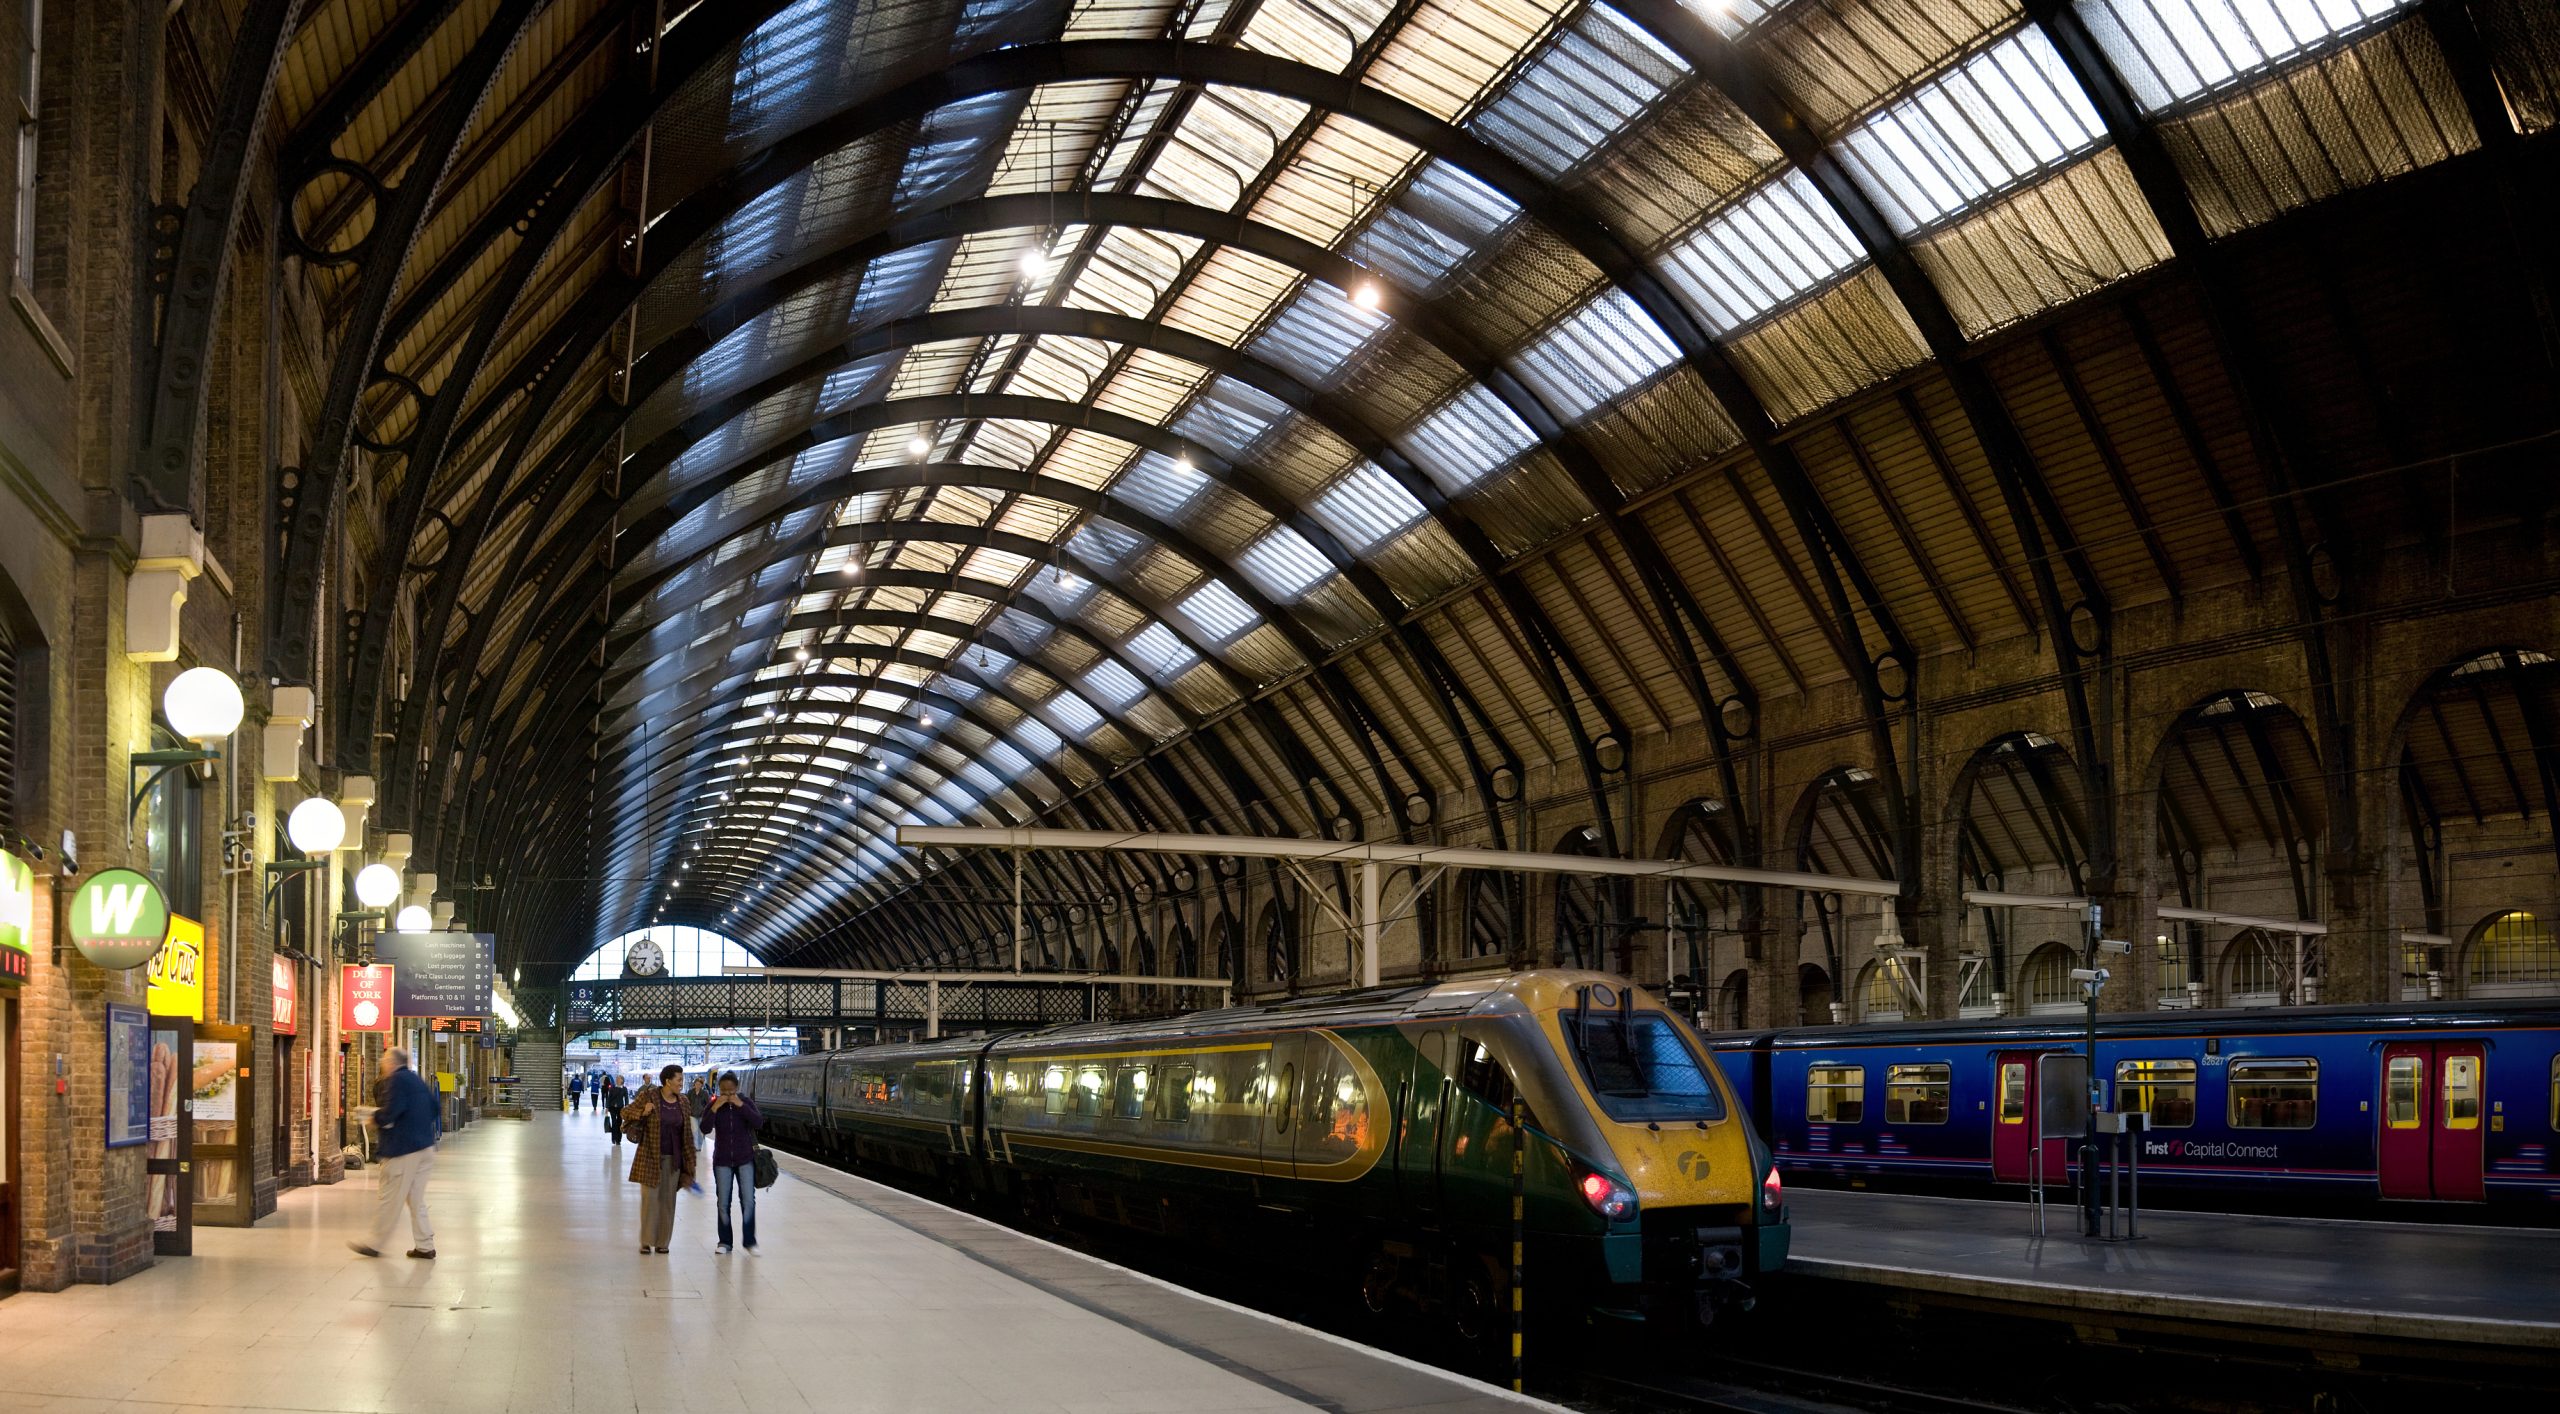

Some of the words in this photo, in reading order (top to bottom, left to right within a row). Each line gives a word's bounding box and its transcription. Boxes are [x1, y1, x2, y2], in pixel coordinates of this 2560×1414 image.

[91, 884, 148, 934] W
[0, 950, 26, 977] INE
[168, 936, 199, 988] Crust
[353, 970, 382, 979] DUKE
[360, 981, 374, 989] OF
[352, 991, 381, 999] YORK
[578, 988, 586, 998] 8
[2201, 1057, 2224, 1066] 62627
[2145, 1141, 2168, 1155] First
[2184, 1141, 2225, 1159] Capital
[2227, 1142, 2278, 1158] Connect
